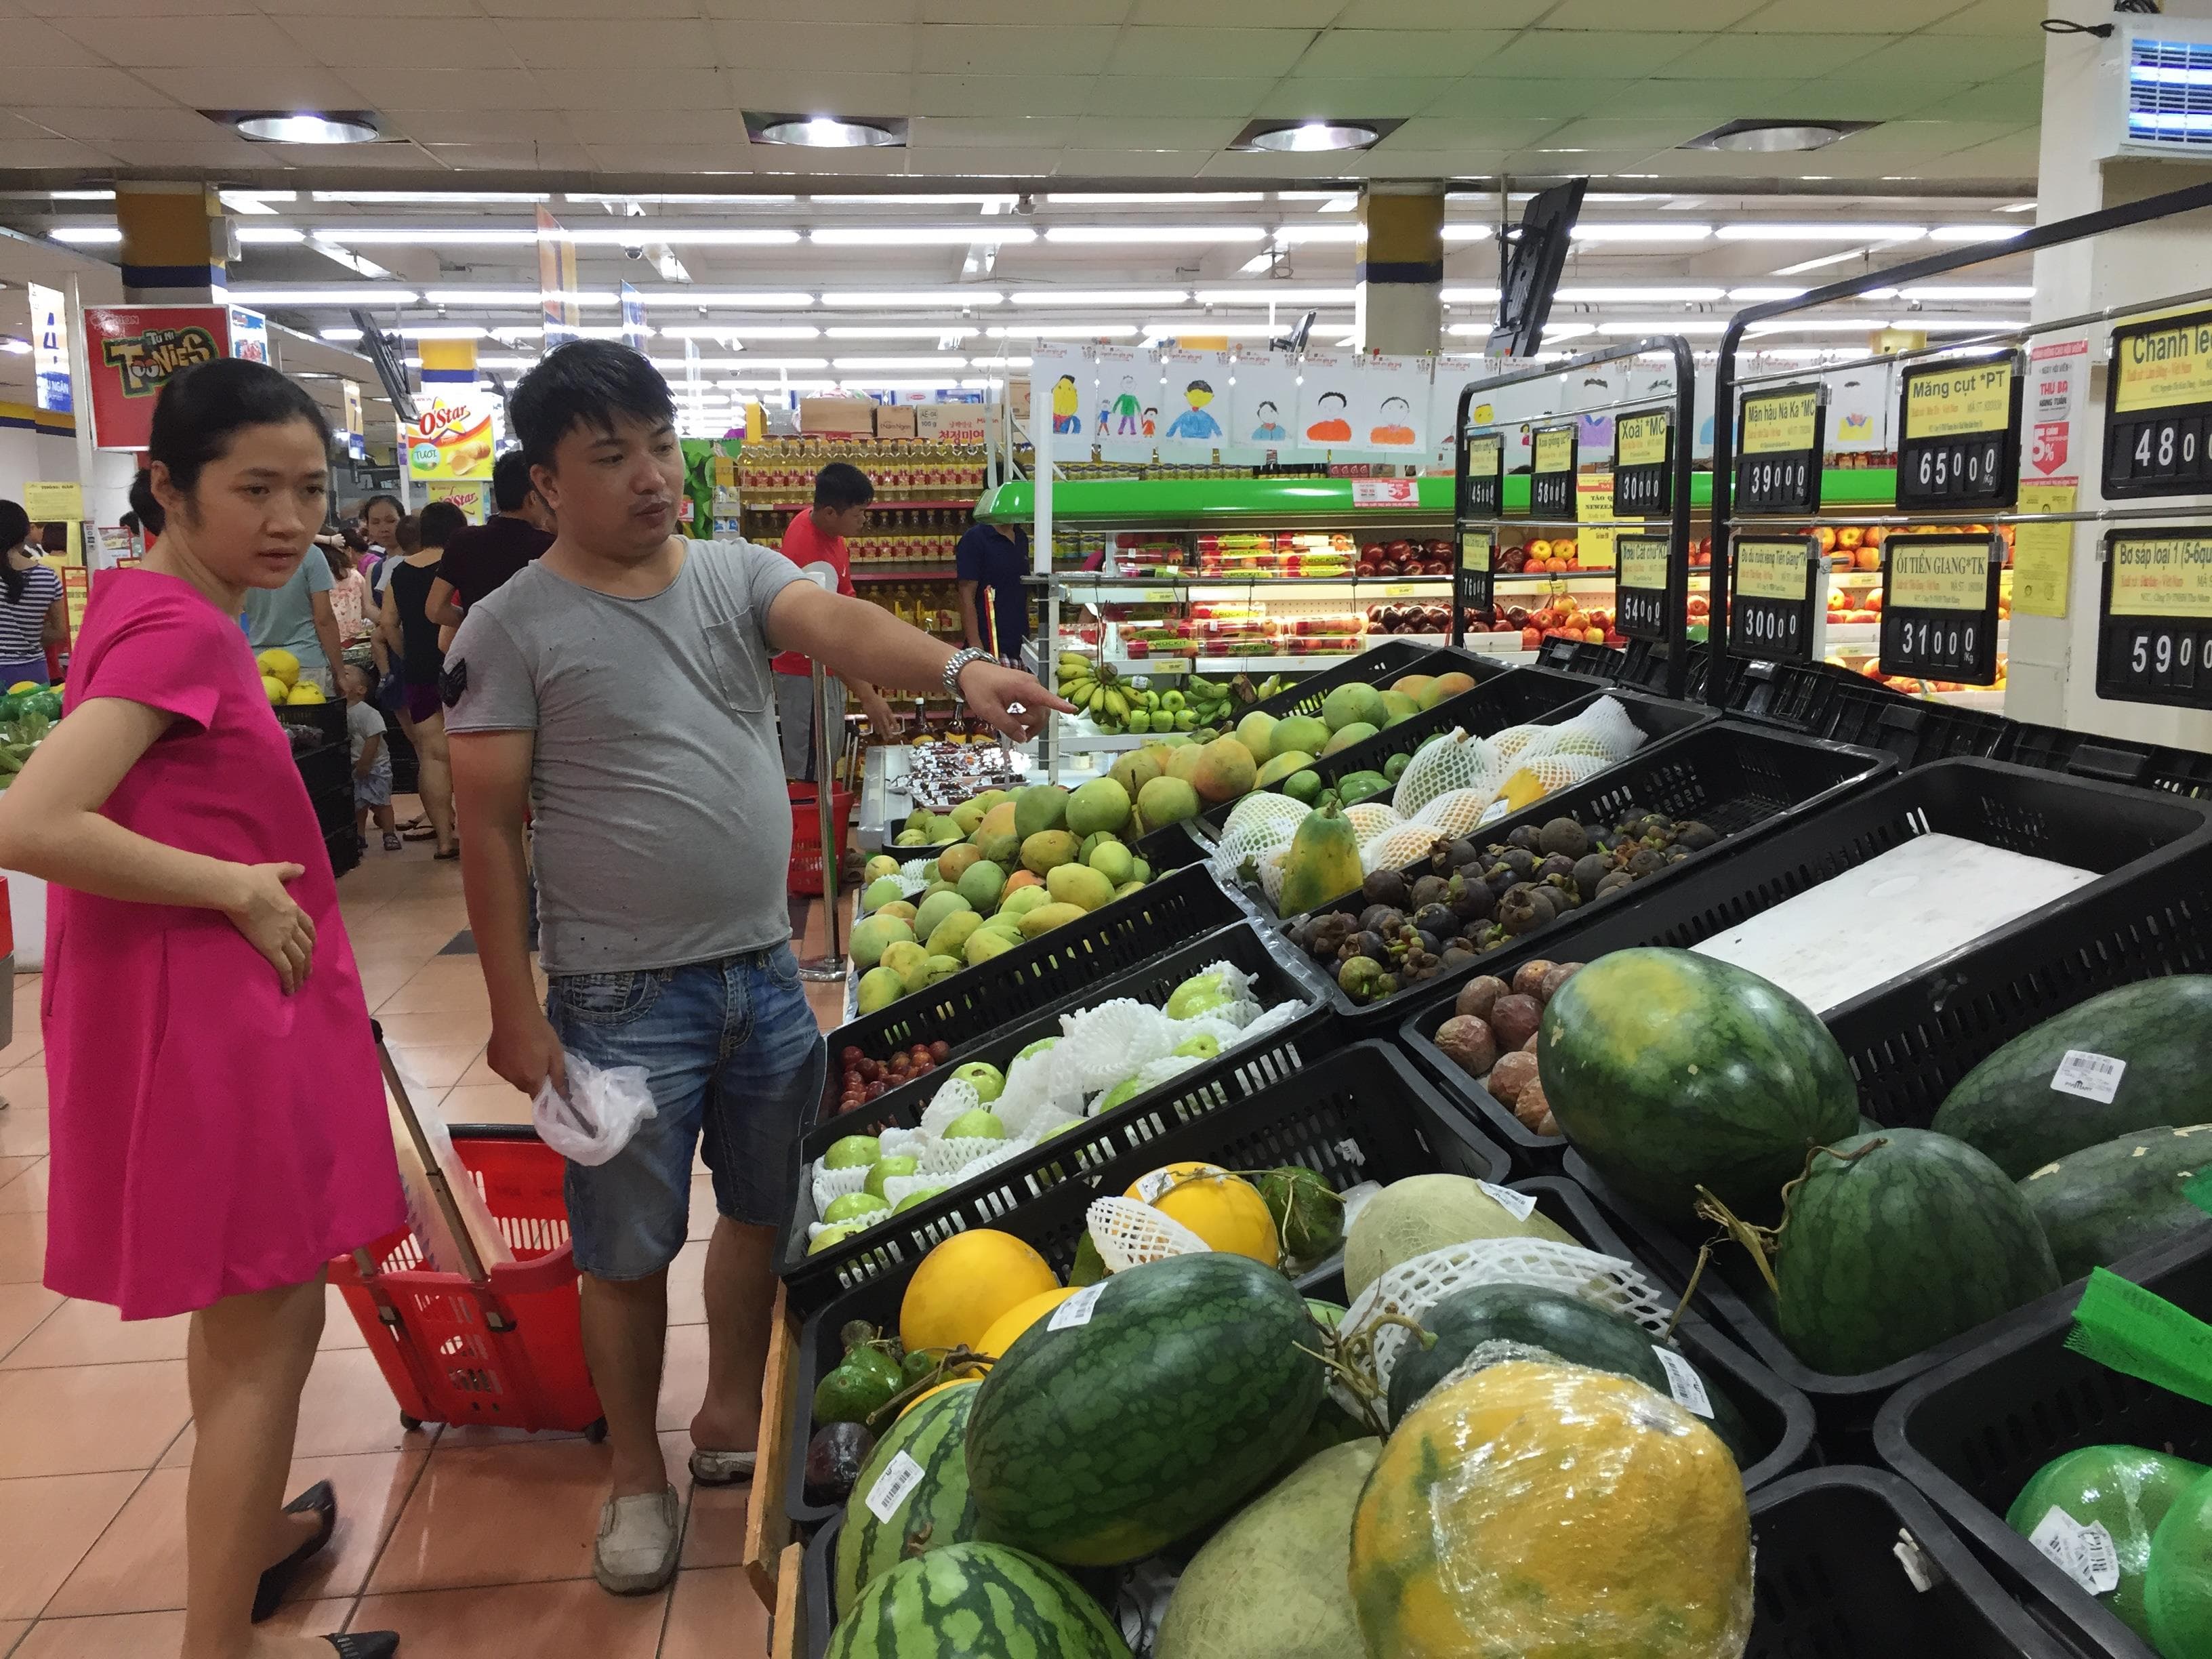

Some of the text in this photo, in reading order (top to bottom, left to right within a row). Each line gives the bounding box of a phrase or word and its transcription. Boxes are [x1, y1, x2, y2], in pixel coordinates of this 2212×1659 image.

[2133, 326, 2212, 364] Chanh le
[1913, 381, 1949, 398] Măng
[1954, 375, 1975, 396] cụt
[419, 405, 467, 436] O'Star
[1622, 419, 1643, 440] Xoài
[1751, 465, 1805, 494] 39000
[1920, 448, 1995, 485] 65000
[1623, 476, 1659, 500] 30000
[1909, 549, 1932, 574] TIỀN
[2120, 544, 2133, 565] Bơ
[2135, 542, 2152, 569] sáp
[1625, 598, 1660, 623] 54000
[1746, 609, 1797, 640] 30000
[1902, 623, 1973, 655] 31000
